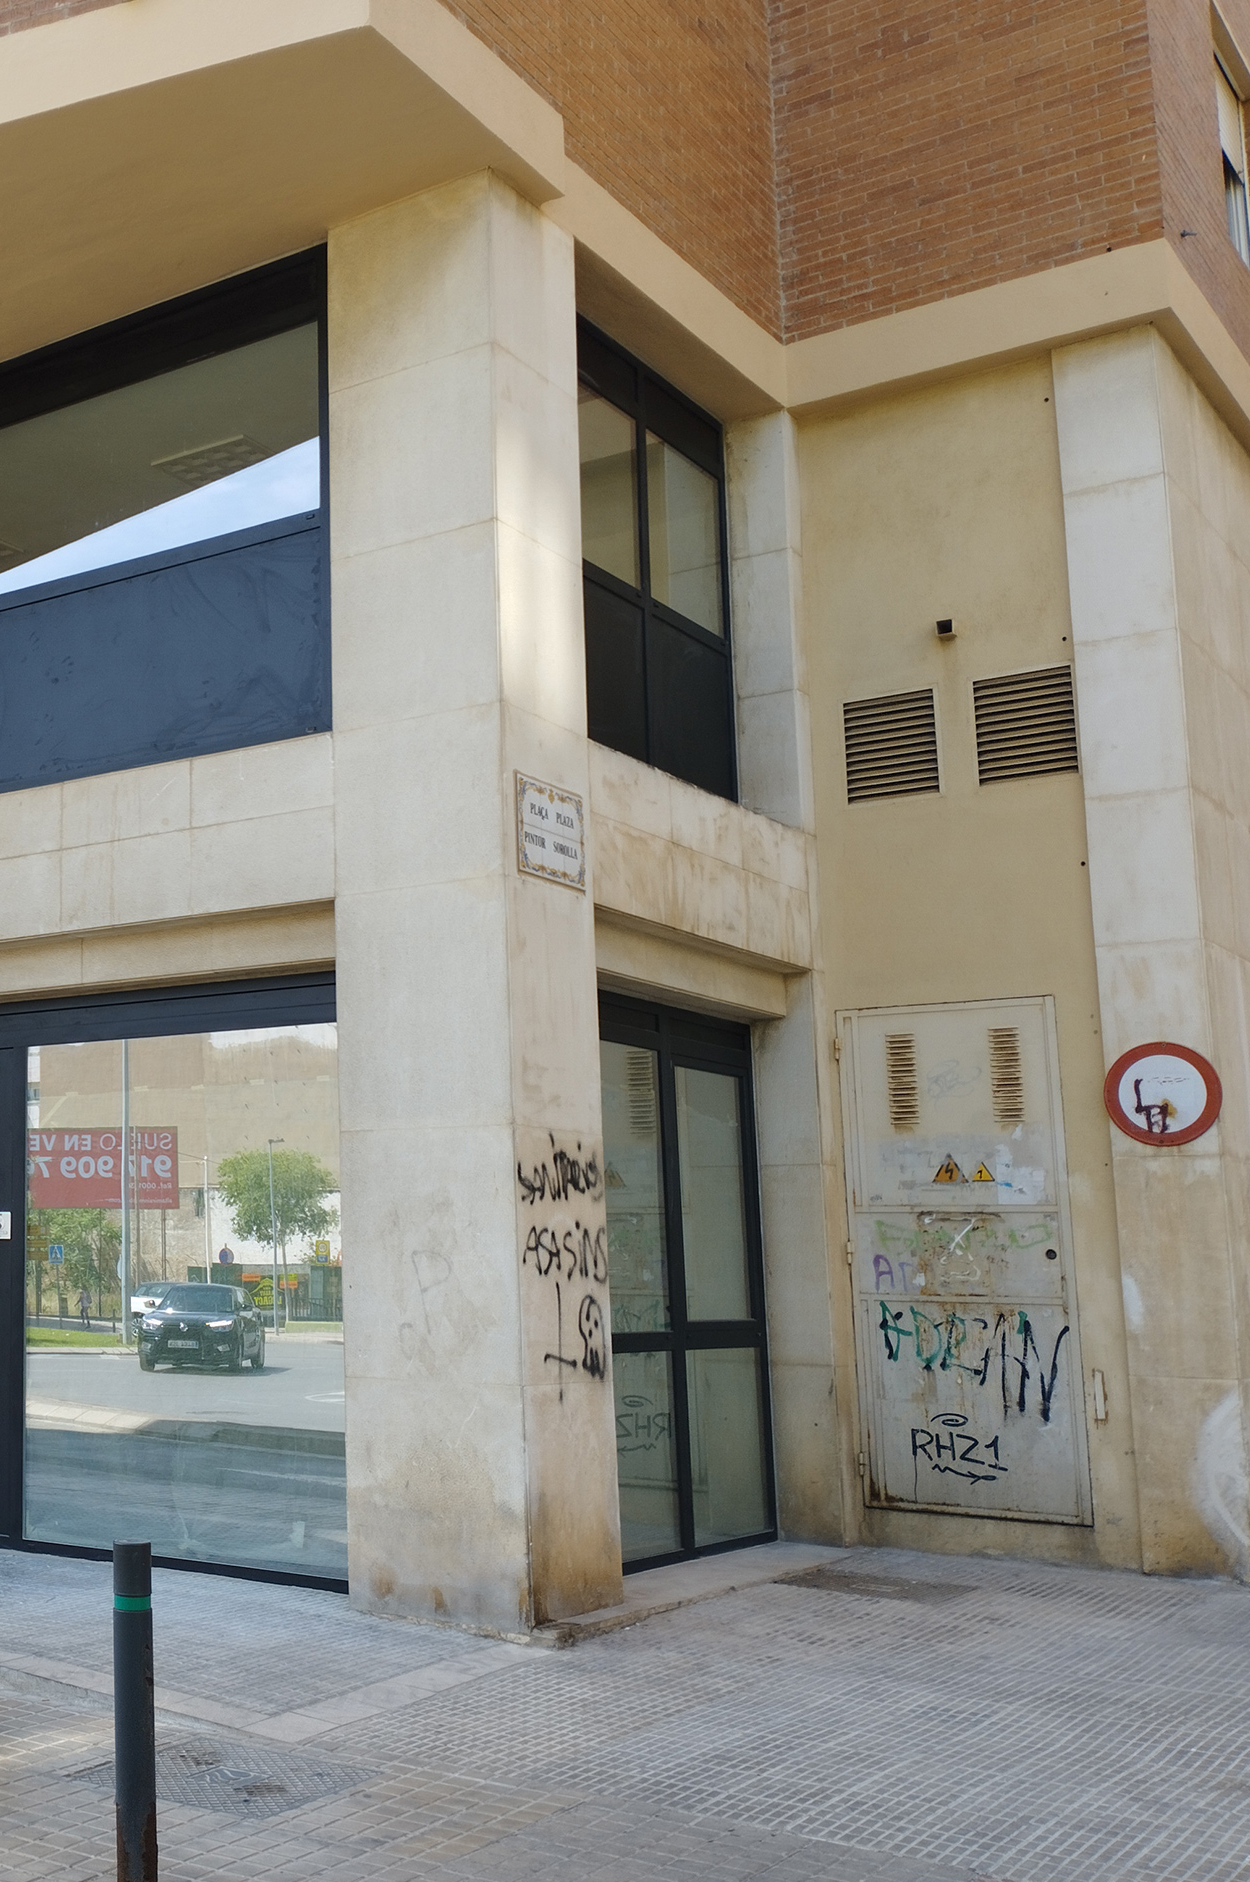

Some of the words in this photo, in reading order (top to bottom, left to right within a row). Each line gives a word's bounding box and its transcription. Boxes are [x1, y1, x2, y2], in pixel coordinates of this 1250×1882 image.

[530, 803, 549, 821] PLAÇA
[556, 812, 575, 829] PLAZA
[524, 831, 546, 849] PINTOR
[553, 841, 578, 860] SOROLLA
